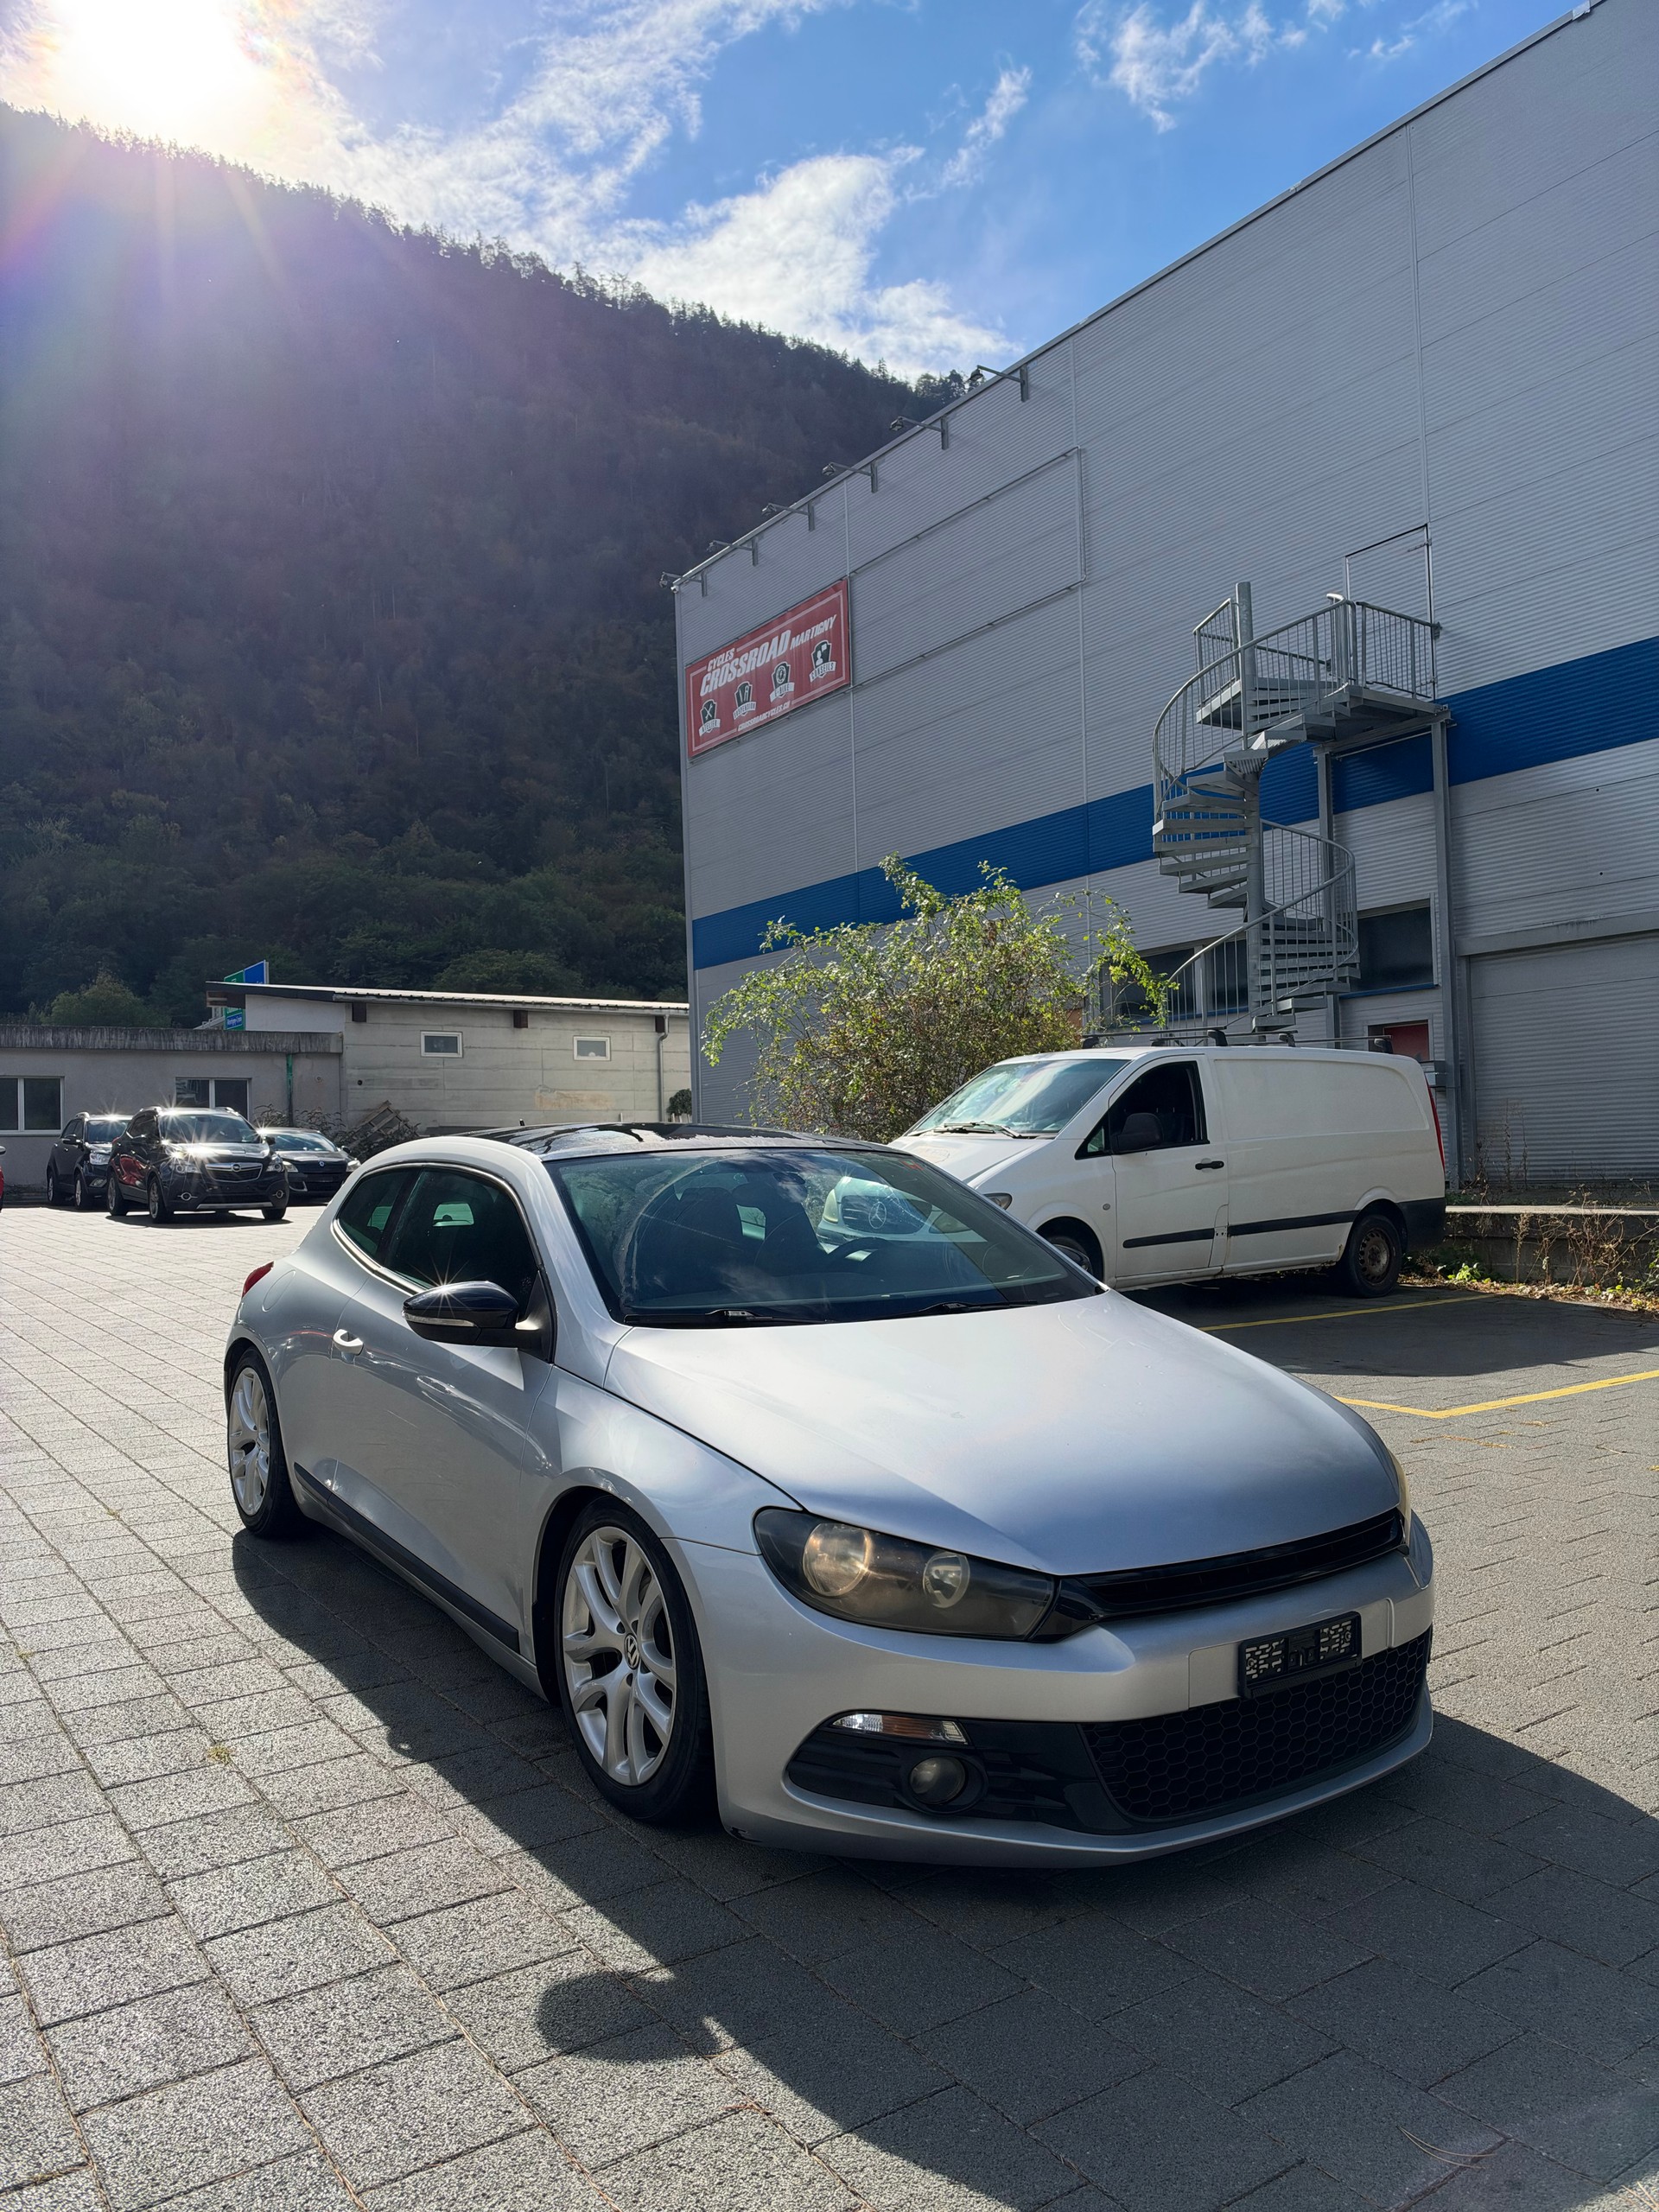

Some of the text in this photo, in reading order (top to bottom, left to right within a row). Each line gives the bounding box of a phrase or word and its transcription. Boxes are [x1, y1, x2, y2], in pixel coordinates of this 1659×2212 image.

[700, 613, 836, 696] CROSSROAD MARTIGNY
[708, 648, 735, 671] CYCLES
[811, 662, 834, 680] CONSEILS
[774, 683, 790, 696] E-BIKE
[702, 719, 718, 733] ATELIER
